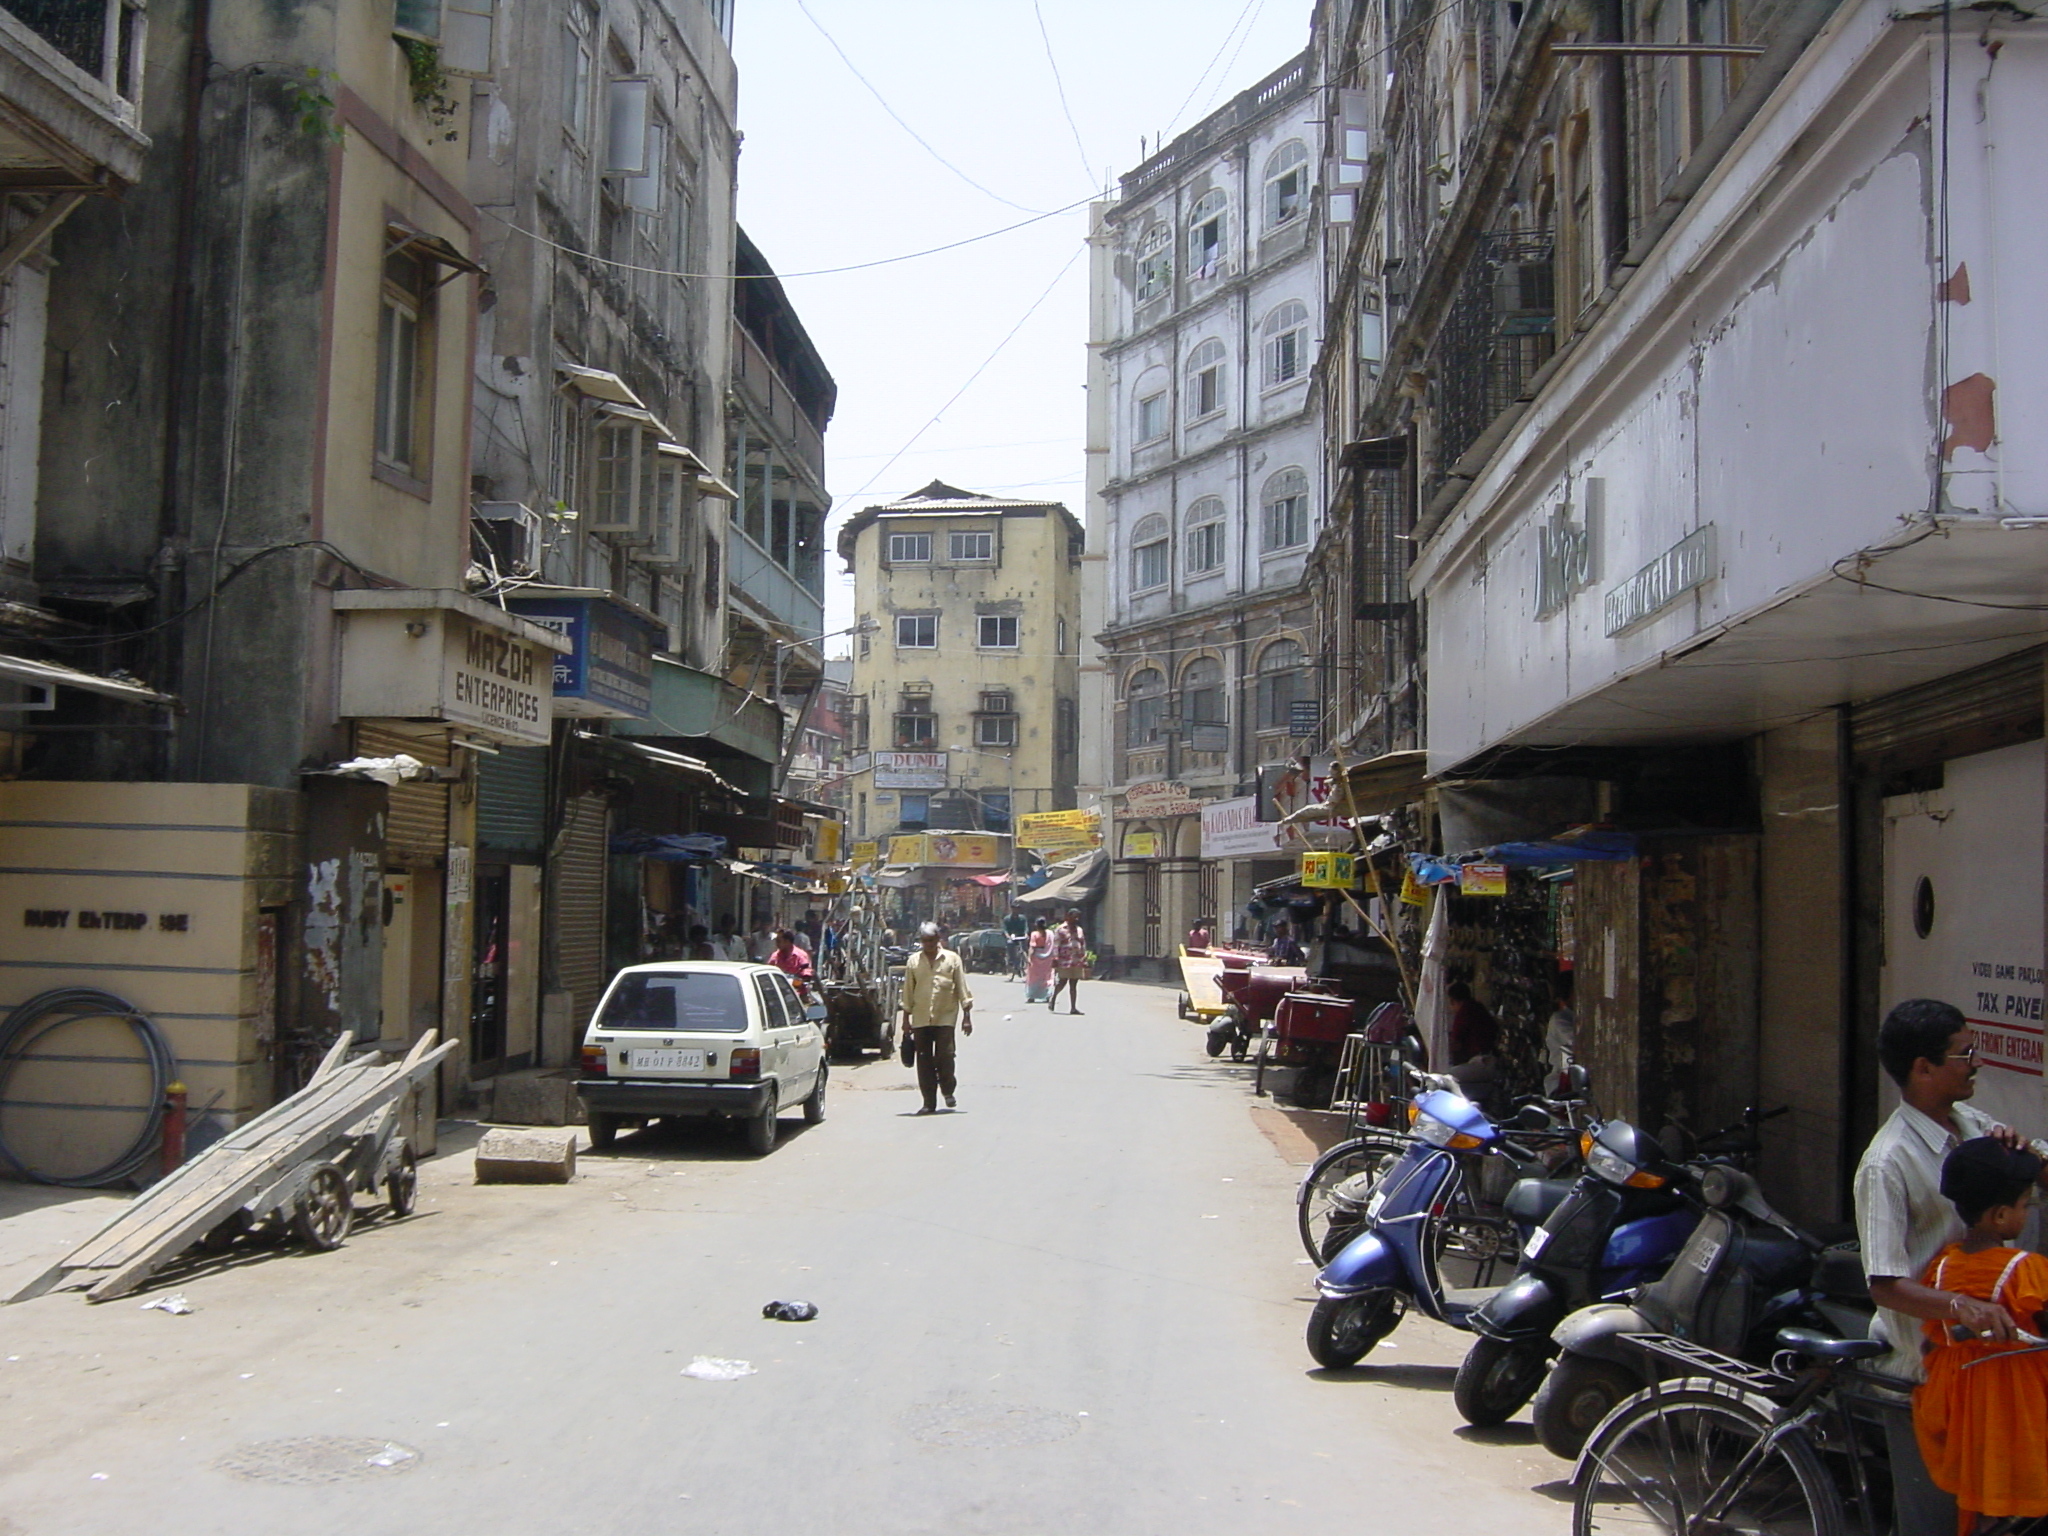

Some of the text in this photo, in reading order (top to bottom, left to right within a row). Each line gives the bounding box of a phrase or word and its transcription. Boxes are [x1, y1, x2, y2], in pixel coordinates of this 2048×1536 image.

[466, 626, 533, 685] MAZDA
[456, 671, 539, 722] ENTERPRISES
[1972, 962, 1992, 978] VIDEO
[1995, 964, 2015, 980] GAME
[1977, 991, 1999, 1013] TAX
